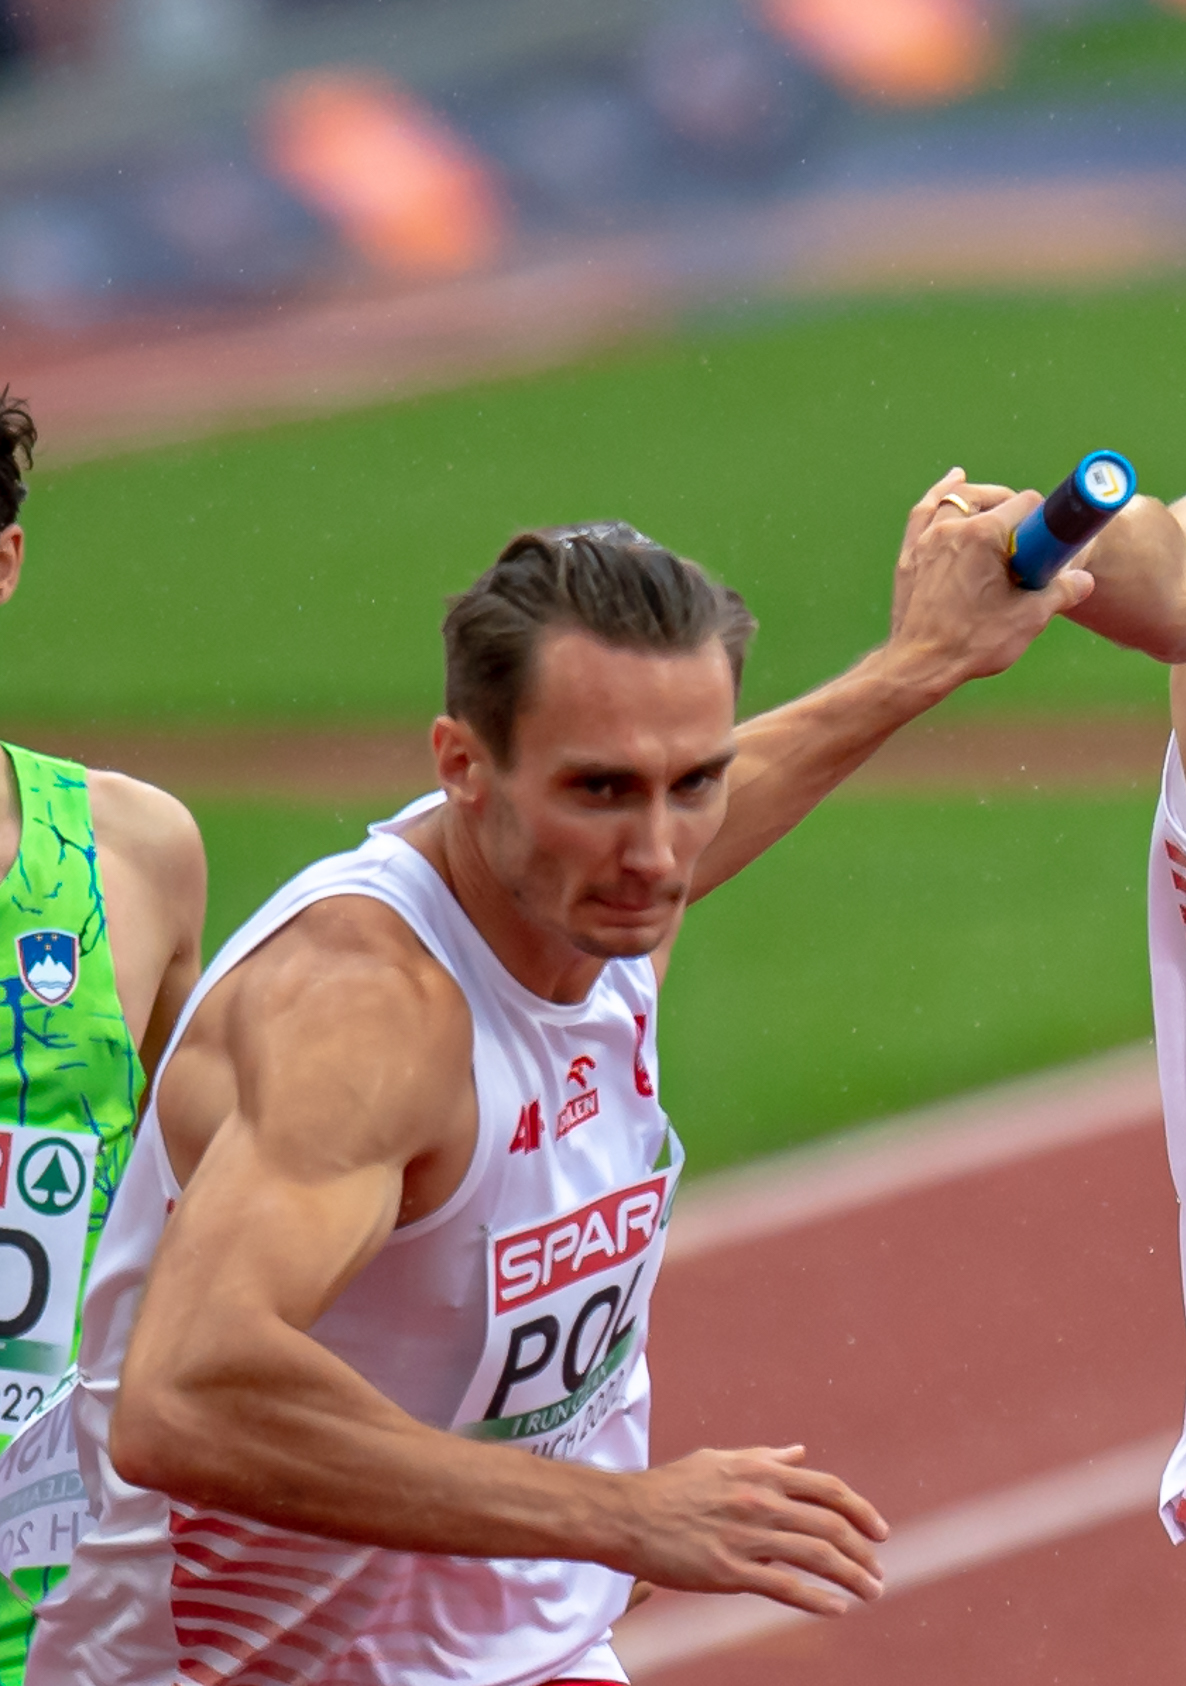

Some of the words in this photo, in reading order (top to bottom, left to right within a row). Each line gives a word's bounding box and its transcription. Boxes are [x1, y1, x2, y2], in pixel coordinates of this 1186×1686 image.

[501, 1190, 660, 1302] SPAR
[483, 1260, 647, 1422] POL
[525, 1402, 567, 1435] RUN
